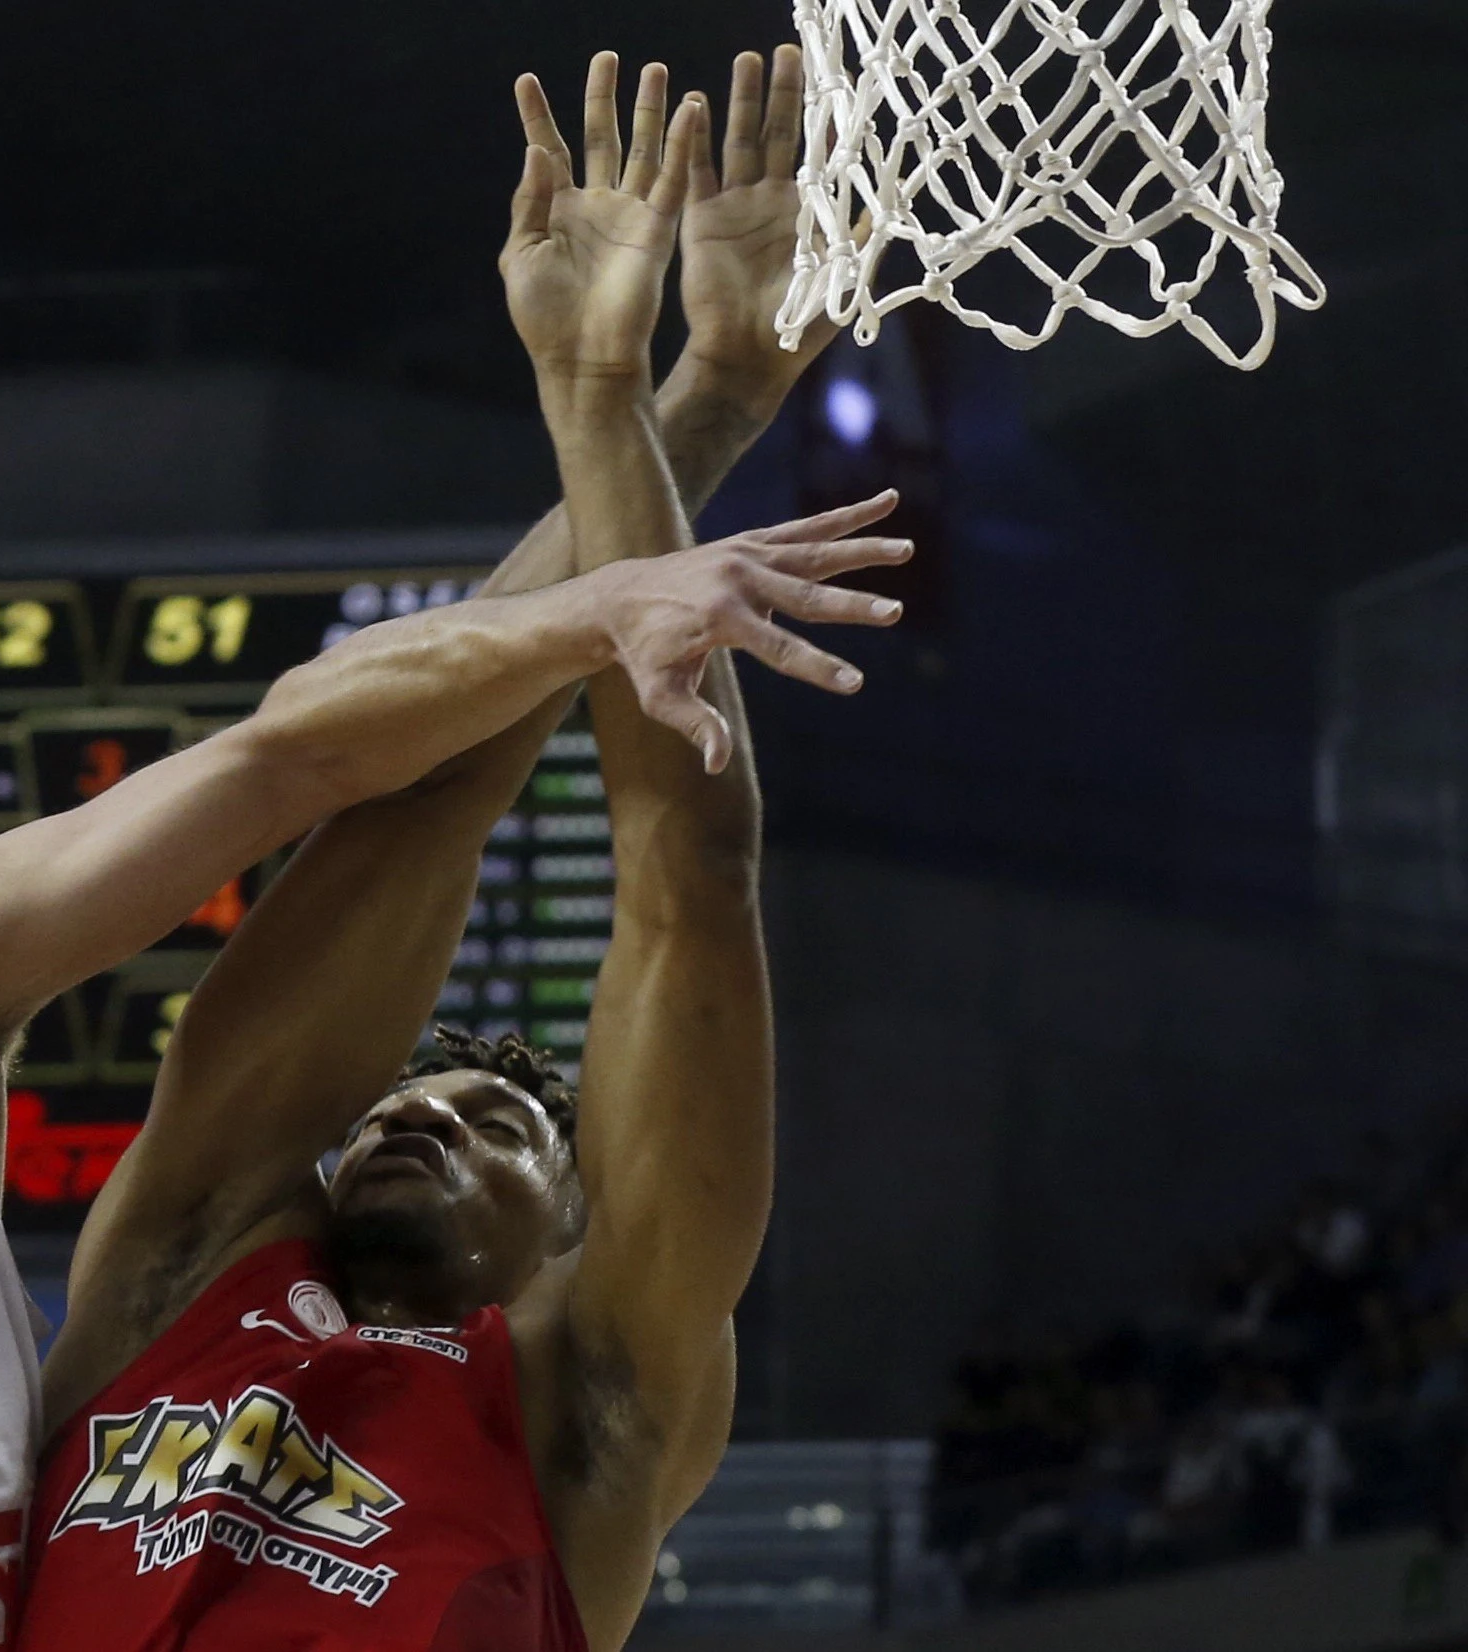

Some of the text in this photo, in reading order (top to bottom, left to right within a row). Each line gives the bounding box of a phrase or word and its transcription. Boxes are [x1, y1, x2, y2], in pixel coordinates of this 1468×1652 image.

[144, 594, 252, 667] 51
[210, 1512, 261, 1563] στη
[263, 1537, 396, 1605] στιγμή
